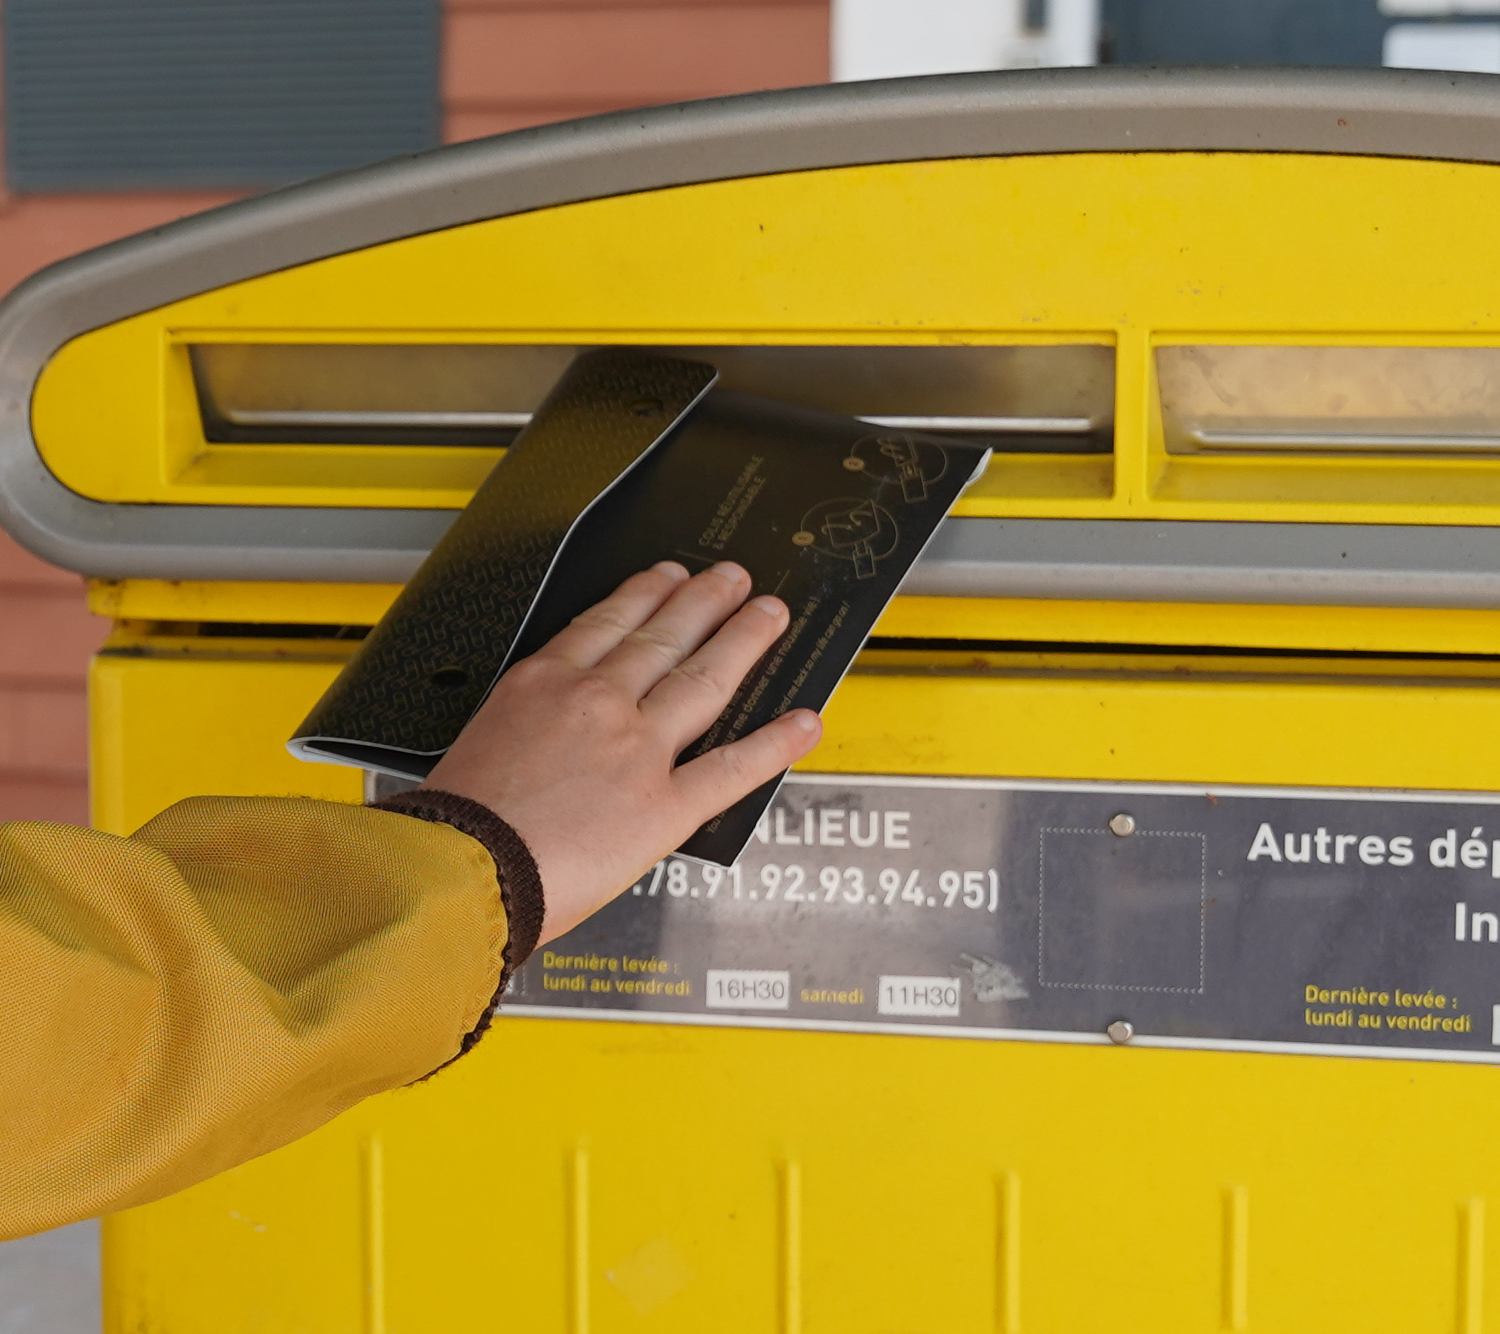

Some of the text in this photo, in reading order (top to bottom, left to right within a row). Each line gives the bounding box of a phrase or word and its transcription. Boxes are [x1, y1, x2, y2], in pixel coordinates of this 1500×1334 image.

[743, 675, 770, 713] donner
[766, 656, 784, 676] une
[777, 616, 808, 656] nouvelle
[755, 807, 911, 850] NLIEUE
[1247, 822, 1414, 867] Autres
[631, 859, 999, 914] .78.91.92.93.94.95)
[543, 950, 618, 972] Dernière
[622, 954, 669, 974] levée
[543, 973, 958, 1007] lundi au vendredi 16H30 samedi 11H30
[1305, 984, 1390, 1006] Dernière
[1394, 987, 1447, 1010] levée
[1304, 1007, 1354, 1027] lundi
[1358, 1013, 1382, 1029] au
[1386, 1012, 1473, 1033] vendredi
